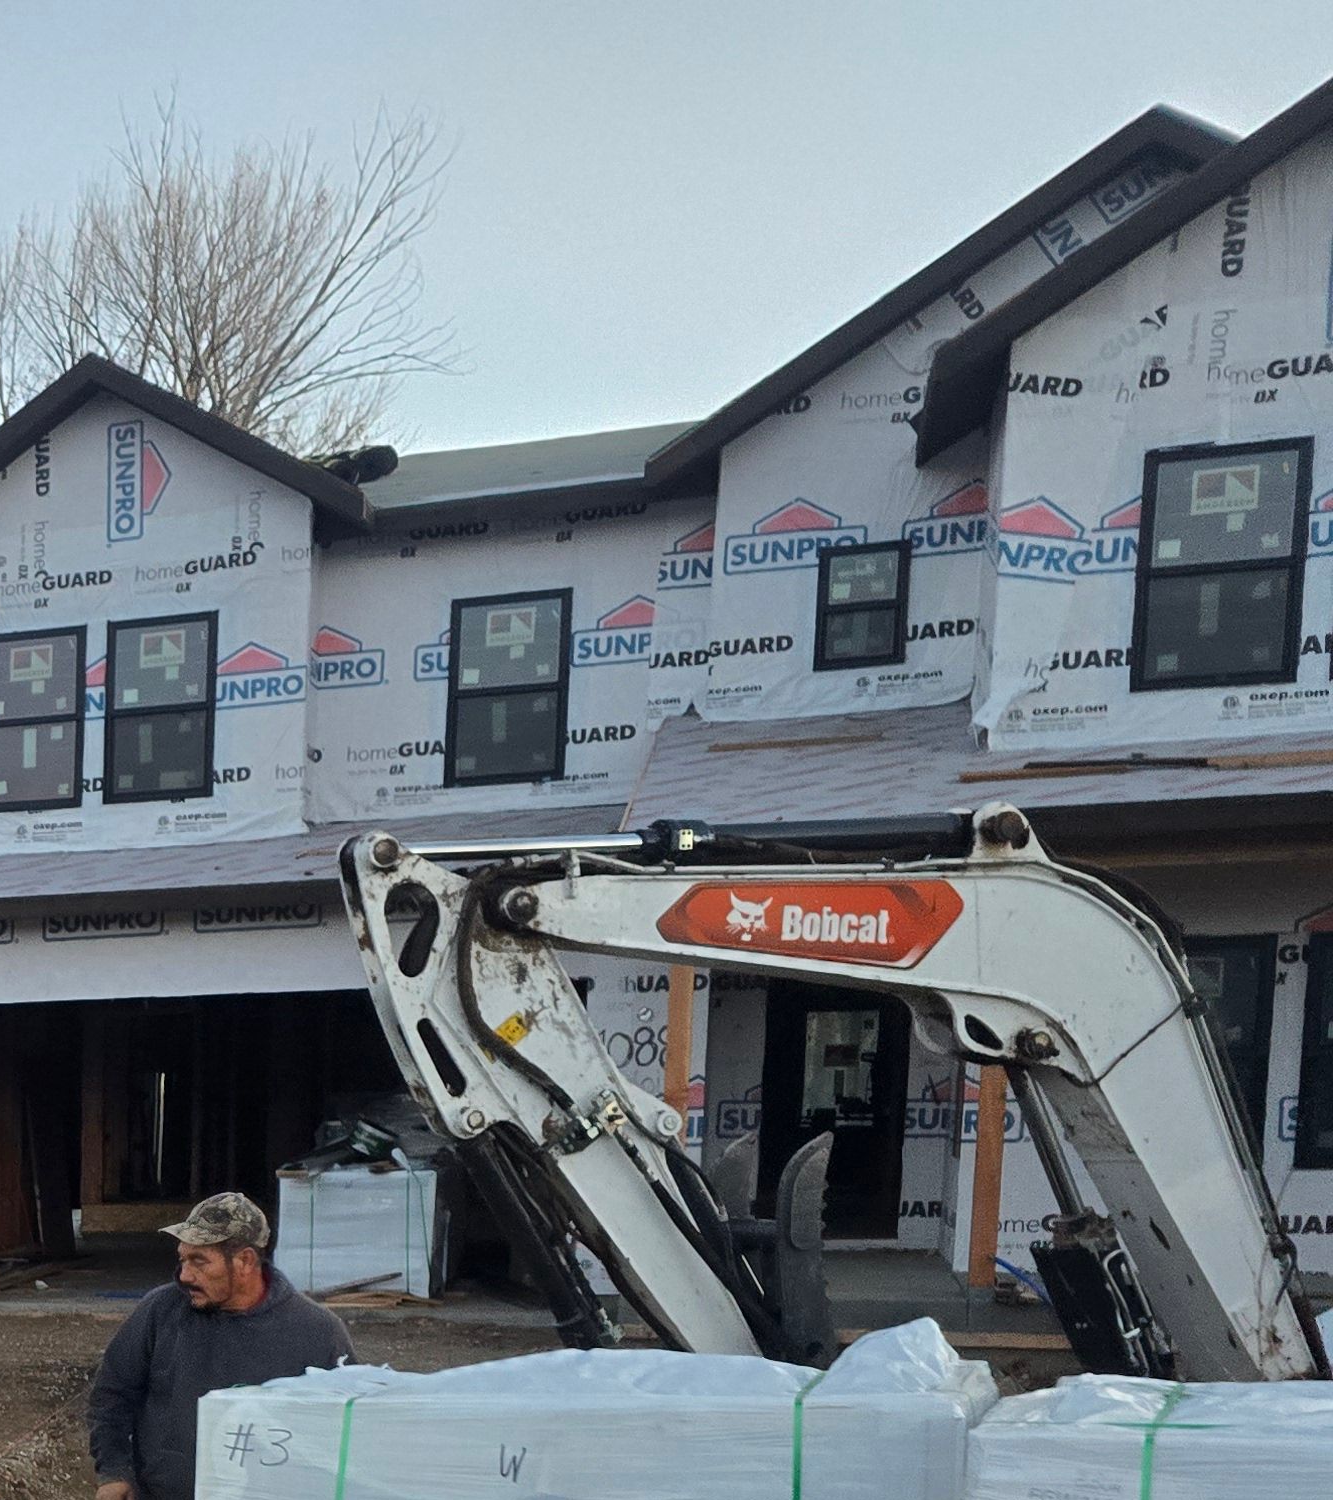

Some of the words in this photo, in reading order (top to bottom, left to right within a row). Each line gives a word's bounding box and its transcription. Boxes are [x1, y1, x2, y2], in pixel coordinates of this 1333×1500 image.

[114, 424, 136, 535] SUNPRO
[134, 550, 257, 583] homeGUARD
[780, 904, 890, 944] Bobcat
[223, 1423, 293, 1468] #3
